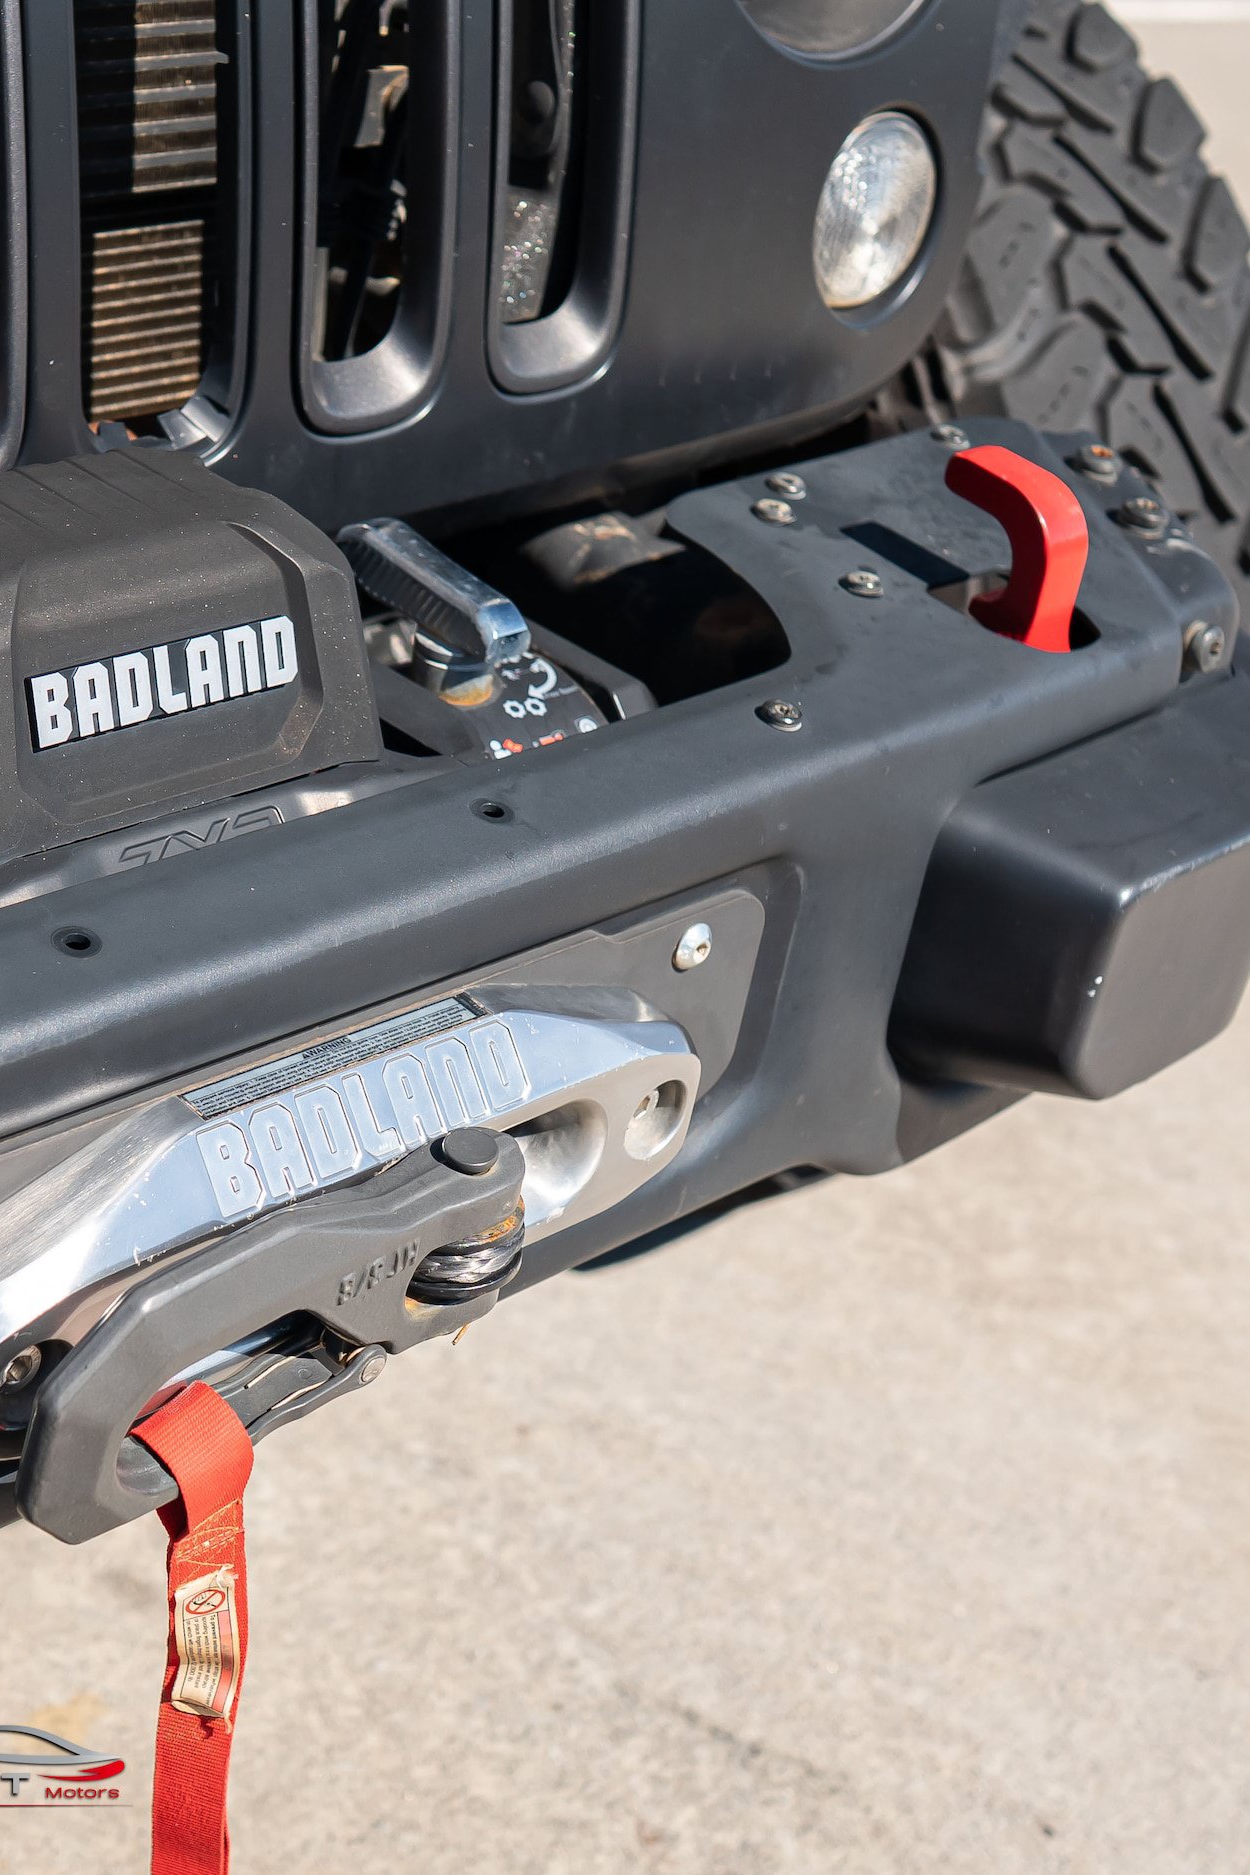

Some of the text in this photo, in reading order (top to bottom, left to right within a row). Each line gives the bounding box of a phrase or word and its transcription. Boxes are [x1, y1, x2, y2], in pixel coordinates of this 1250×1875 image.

[30, 615, 299, 749] BADLAND
[307, 1037, 352, 1058] WARNING
[196, 1020, 532, 1218] BADLAND
